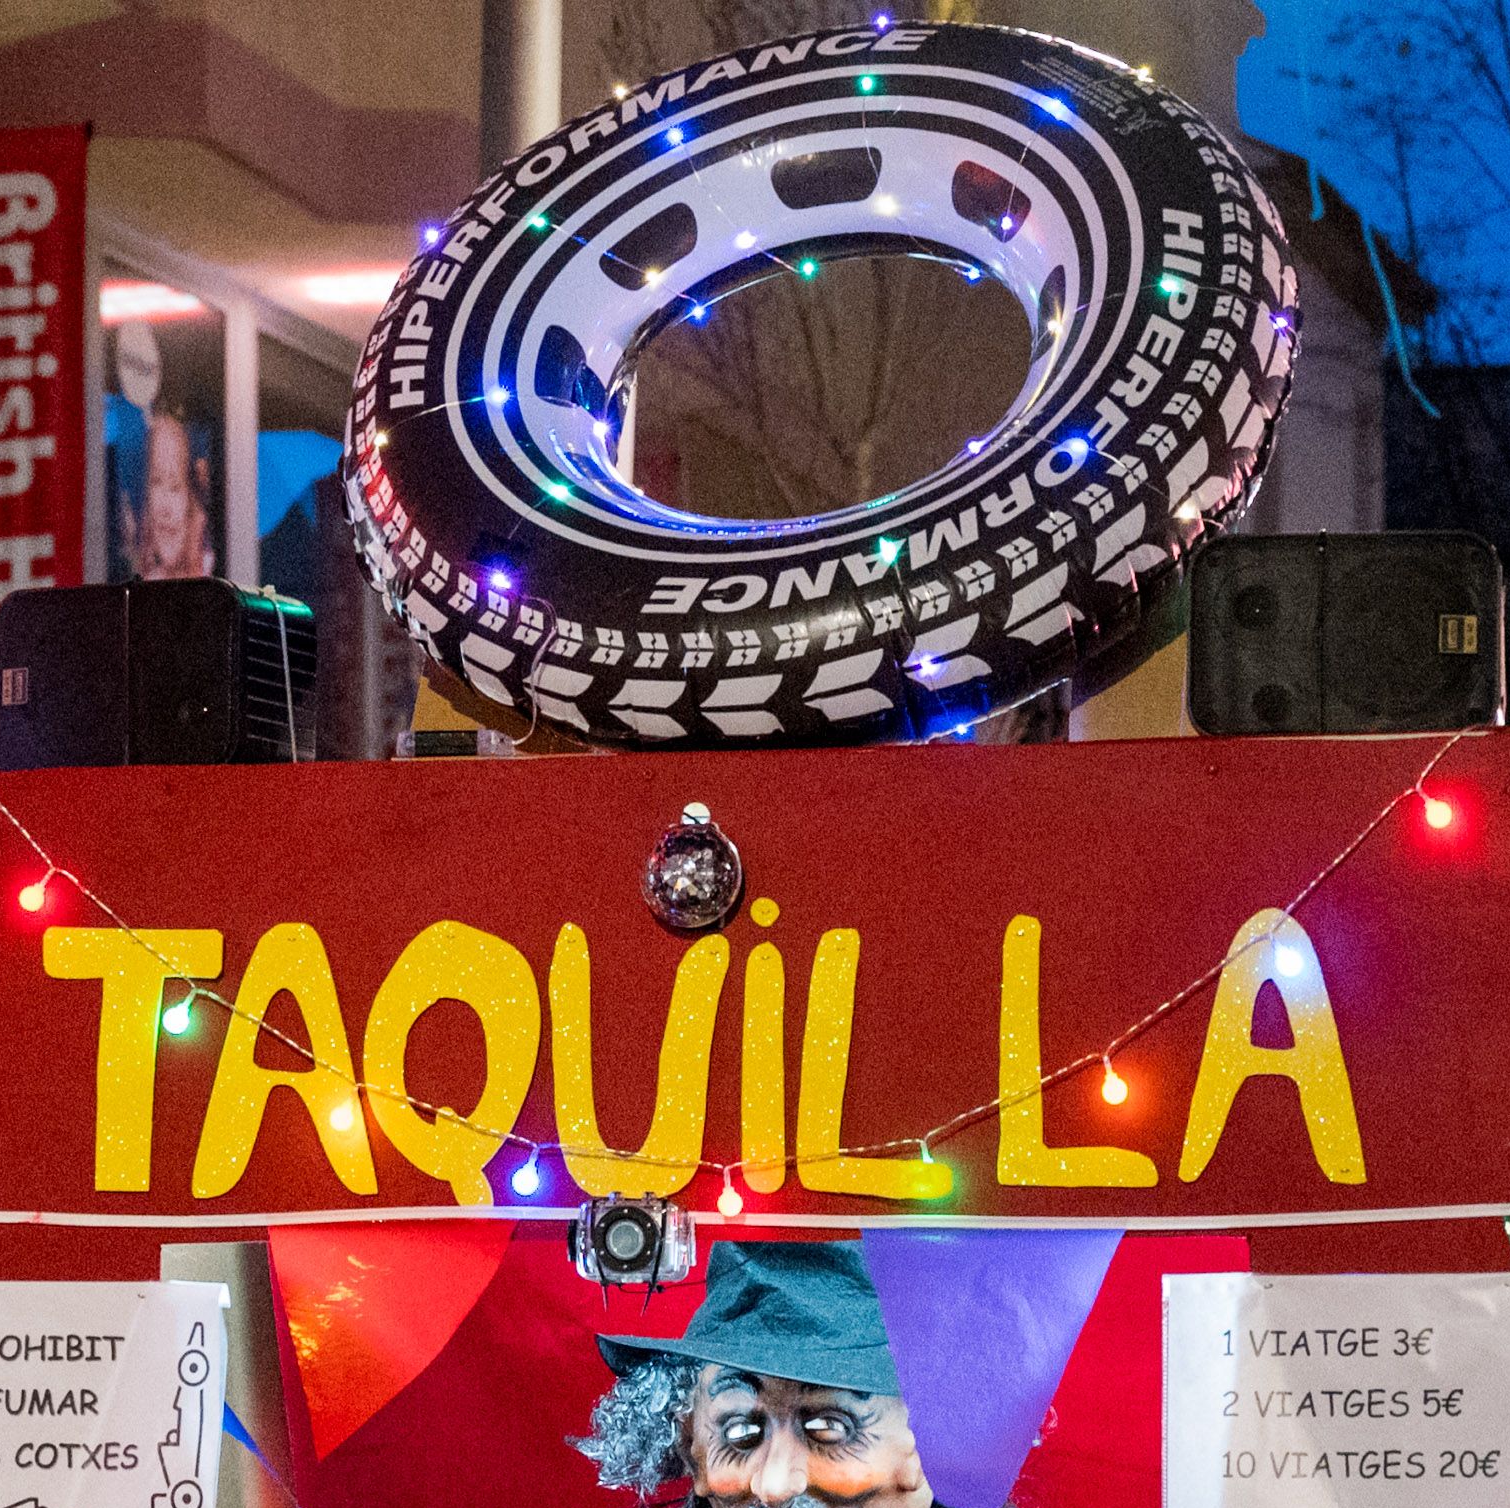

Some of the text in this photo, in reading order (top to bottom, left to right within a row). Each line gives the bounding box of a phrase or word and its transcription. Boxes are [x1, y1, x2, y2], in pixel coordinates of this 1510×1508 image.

[389, 28, 936, 408] HIPERFORMANCE
[1222, 1327, 1434, 1360] 1 VIATGE 3€
[1222, 1388, 1466, 1421] 2 VIATGES 5€
[14, 1441, 141, 1473] COTXES
[1222, 1448, 1502, 1483] 10 VIATGES 20€
